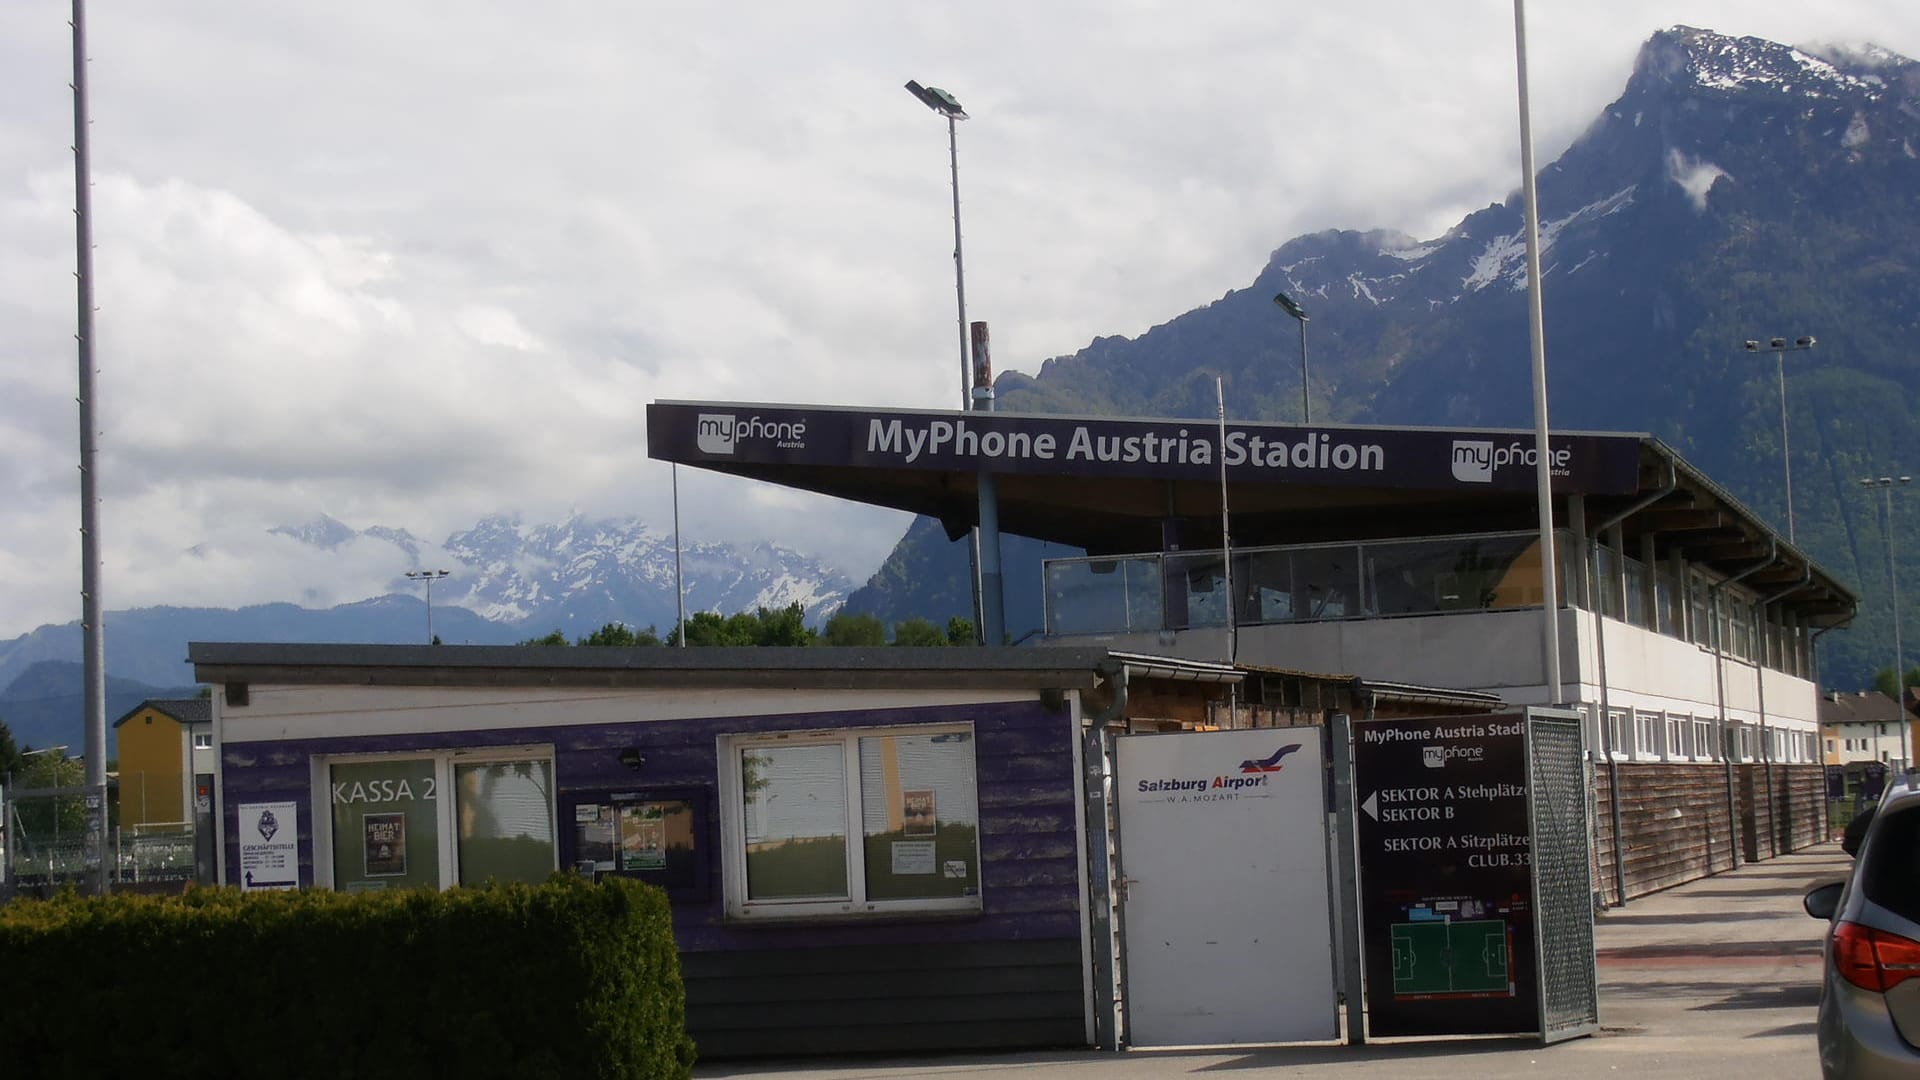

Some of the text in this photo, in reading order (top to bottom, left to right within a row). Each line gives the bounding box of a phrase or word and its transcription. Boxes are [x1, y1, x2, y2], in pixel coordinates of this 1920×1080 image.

[699, 415, 806, 444] myphone
[777, 441, 805, 449] Austria
[867, 418, 1385, 471] MyPhone Austria Stadion
[1364, 721, 1524, 745] MyPhone Austria Stadi
[1424, 745, 1483, 762] myphone
[332, 777, 436, 804] KASSA 2
[1138, 774, 1268, 792] Salzburg Airport
[1381, 787, 1439, 803] SEKTOR
[1443, 786, 1455, 801] A
[1382, 807, 1455, 823] SEKTOR B
[368, 822, 400, 833] HEIMAT
[374, 831, 395, 841] BIER
[1384, 832, 1530, 852] SEKTOR A Sitzplätze
[1468, 853, 1531, 868] CLUB.33
